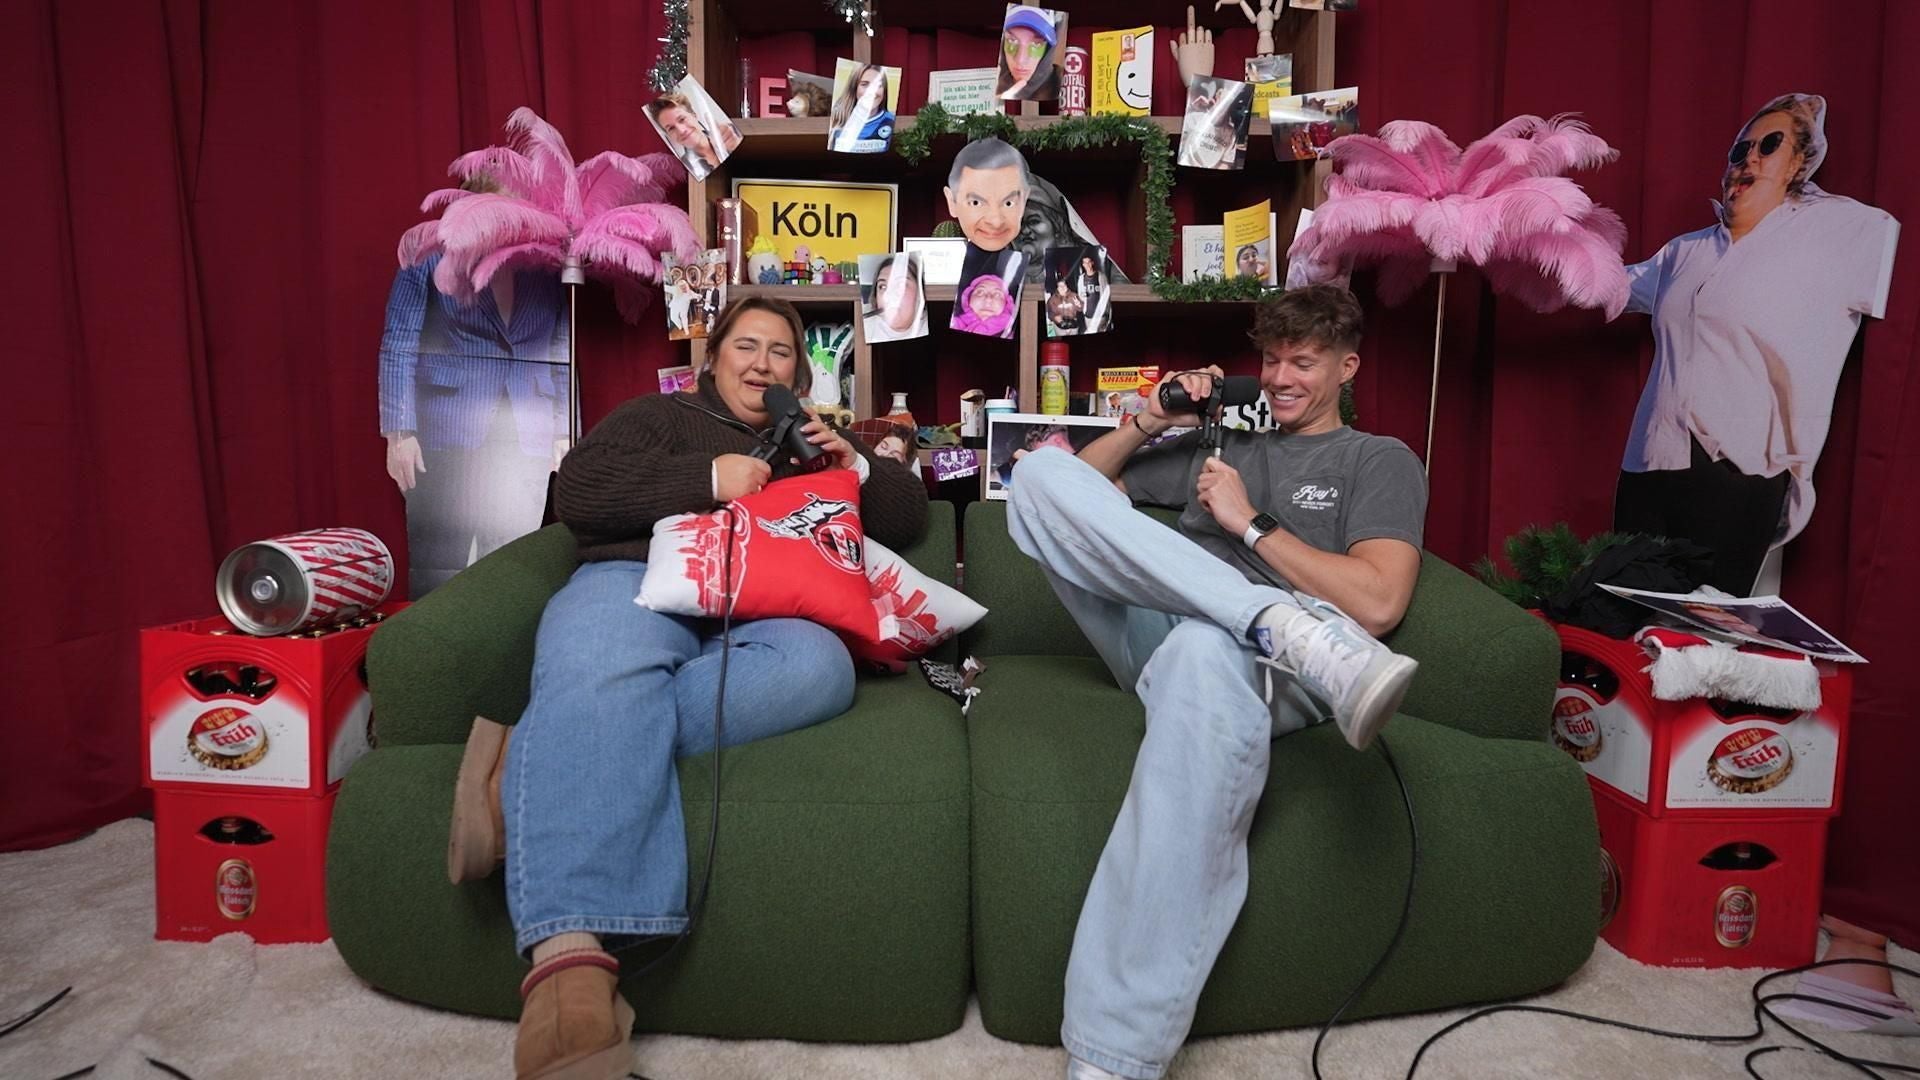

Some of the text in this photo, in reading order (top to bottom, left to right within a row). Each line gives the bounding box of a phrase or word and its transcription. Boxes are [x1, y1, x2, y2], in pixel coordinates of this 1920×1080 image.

[760, 77, 787, 118] E
[1059, 86, 1086, 110] BIER
[772, 201, 858, 238] Köln
[210, 723, 257, 746] früh
[1564, 715, 1595, 736] früh
[1732, 744, 1783, 769] früh
